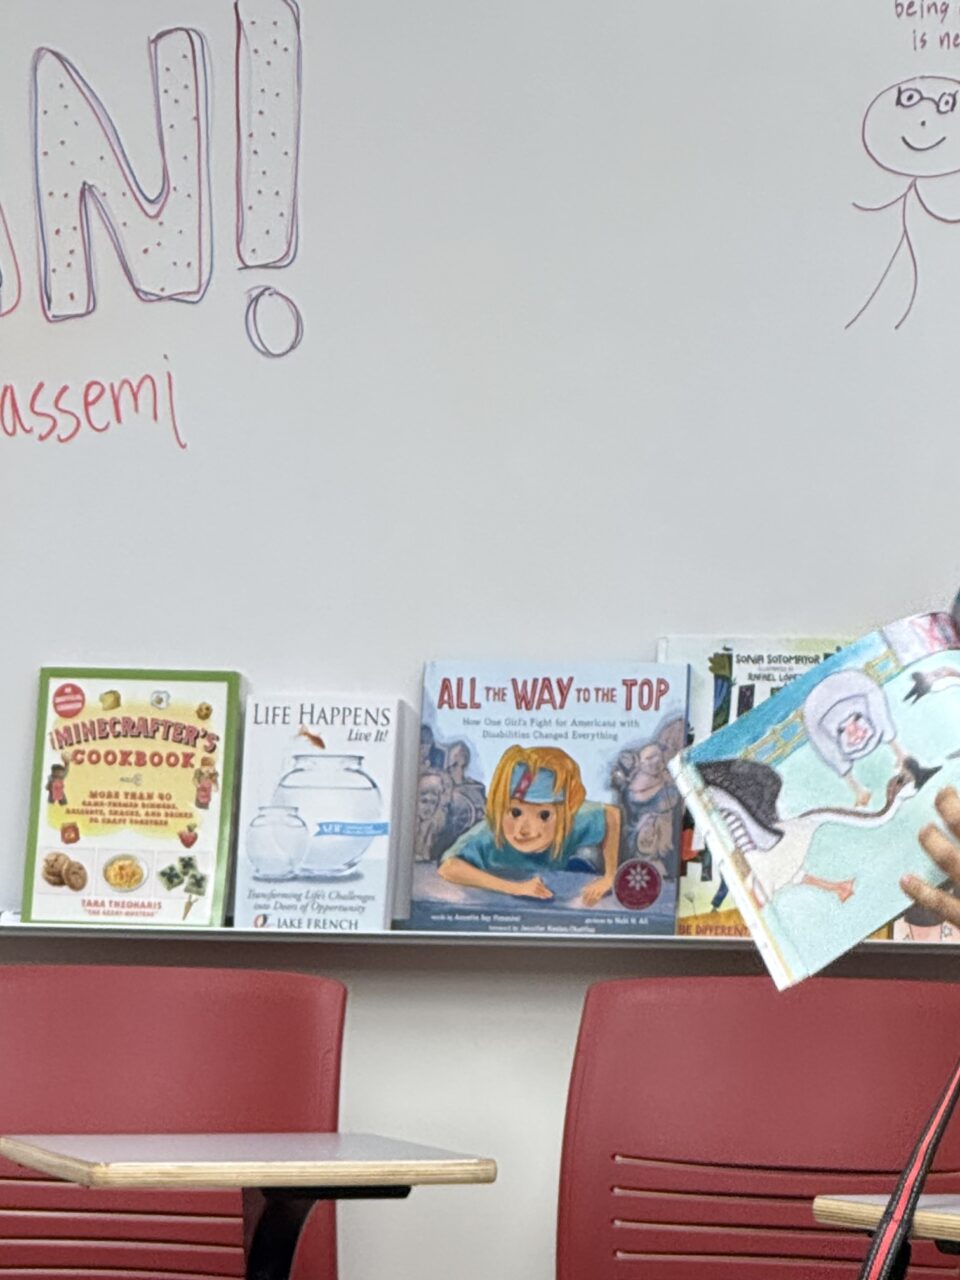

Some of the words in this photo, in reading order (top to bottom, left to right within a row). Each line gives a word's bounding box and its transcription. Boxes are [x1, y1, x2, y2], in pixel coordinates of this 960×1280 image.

[895, 0, 949, 23] being
[913, 29, 927, 51] is
[735, 653, 764, 664] SONIA
[767, 653, 820, 664] SOTOMAYOR
[437, 677, 482, 710] ALL
[484, 686, 508, 703] THE
[511, 676, 574, 711] WAY
[575, 687, 591, 703] TO
[594, 687, 617, 703] THE
[622, 678, 671, 711] TOP
[253, 703, 291, 725] LIFE
[300, 703, 391, 727] HAPPENS
[462, 717, 482, 727] How
[484, 717, 502, 726] One
[504, 718, 528, 727] Girl's
[530, 718, 552, 728] Fight
[555, 718, 569, 727] for
[570, 719, 617, 728] Americans
[619, 719, 640, 728] with
[54, 716, 220, 753] MINECRAFTER'S
[347, 728, 372, 742] Live
[373, 729, 389, 743] It!
[482, 730, 530, 740] Disabilities
[533, 731, 569, 741] Changed
[571, 731, 618, 742] Everything
[71, 749, 195, 768] COOKBOOK
[89, 790, 121, 800] MORE
[123, 791, 155, 801] THAN
[157, 791, 172, 801] 40
[247, 889, 303, 901] Transforming
[305, 889, 327, 901] Life's
[328, 890, 375, 903] Challenges
[81, 899, 105, 908] TARA
[273, 900, 298, 911] Doors
[299, 902, 309, 913] of
[311, 901, 366, 914] Opportunity
[277, 918, 303, 929] JAKE
[307, 918, 359, 930] FRENCH
[678, 924, 692, 936] BE
